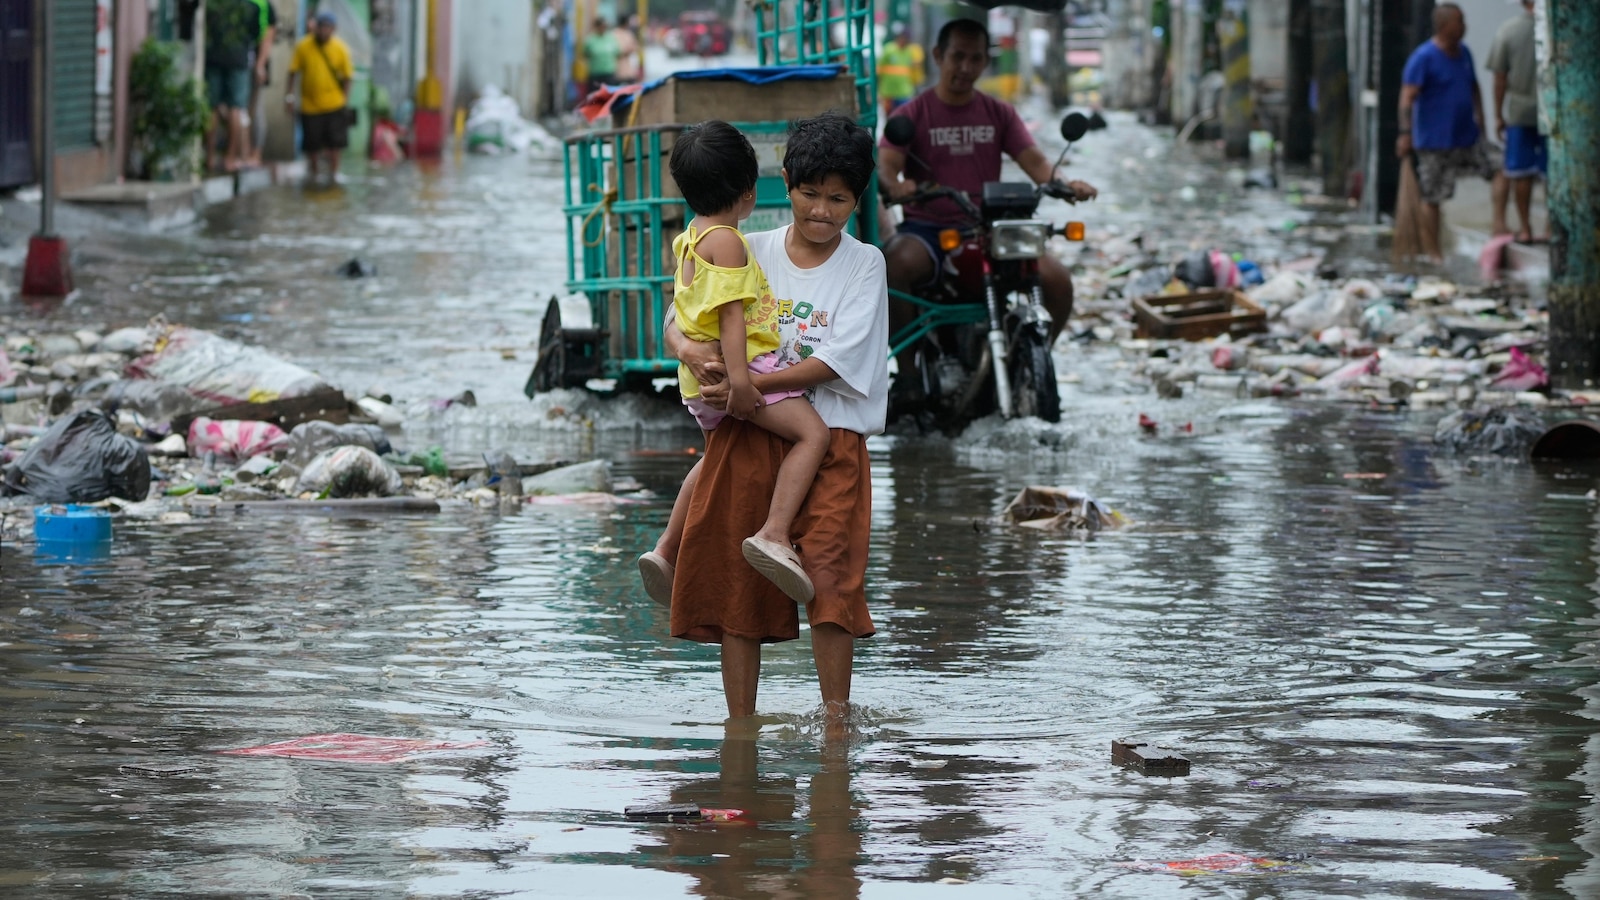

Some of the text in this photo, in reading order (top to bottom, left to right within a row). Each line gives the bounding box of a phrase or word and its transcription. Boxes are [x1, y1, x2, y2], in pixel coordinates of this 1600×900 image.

[929, 125, 995, 146] TOGETHER
[778, 299, 828, 327] RON
[778, 317, 795, 325] sland
[801, 335, 821, 343] CORON
